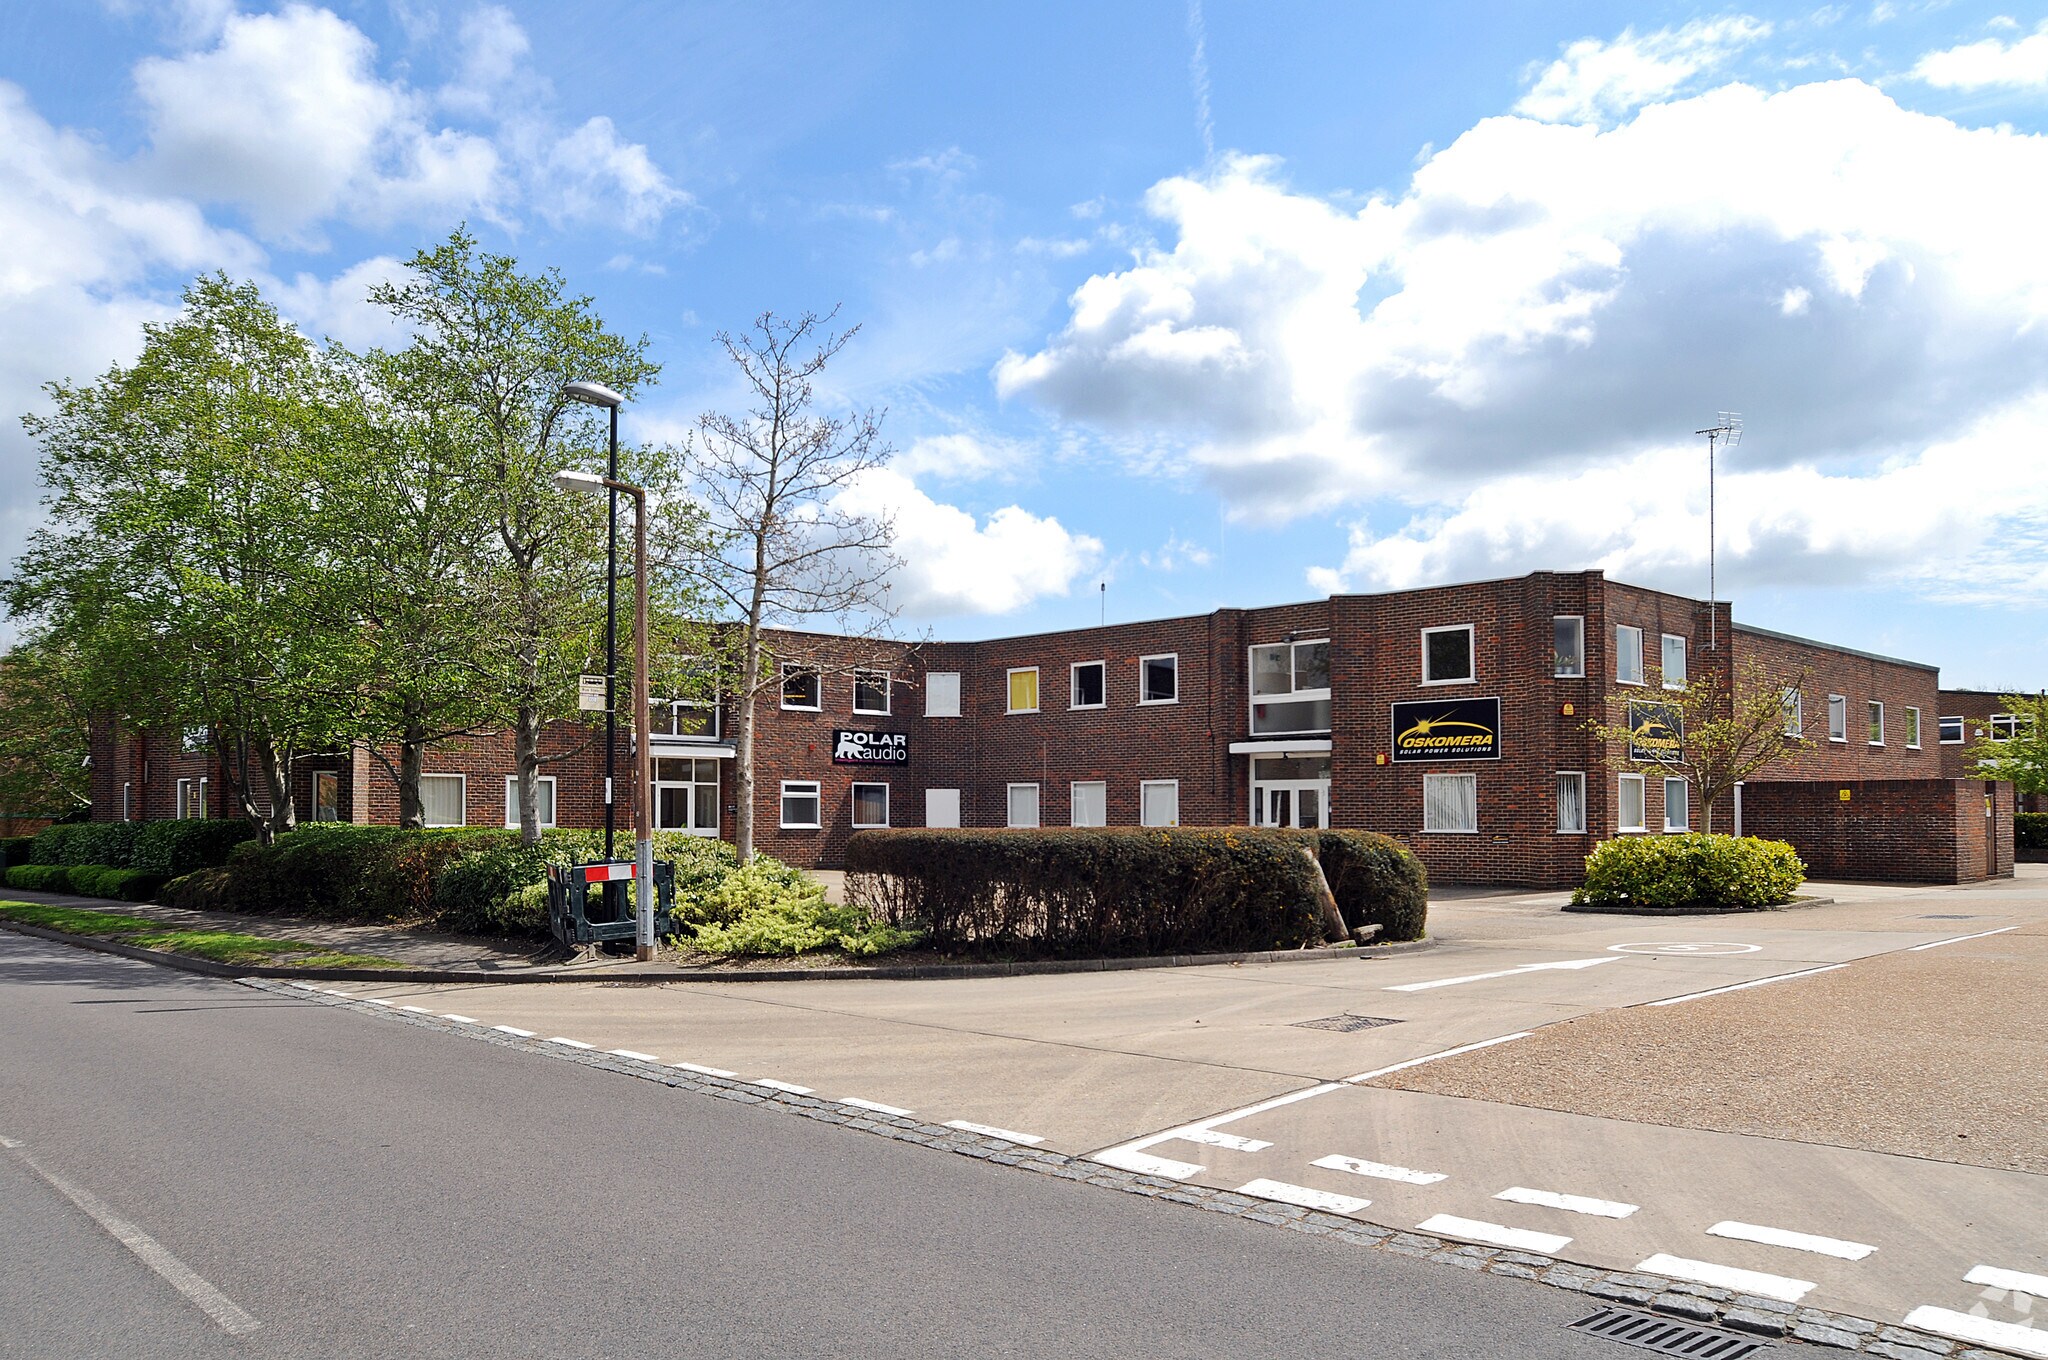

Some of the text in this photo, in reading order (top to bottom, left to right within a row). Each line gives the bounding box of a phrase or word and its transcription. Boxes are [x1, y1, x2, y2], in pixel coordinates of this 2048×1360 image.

[840, 732, 906, 746] POLAR
[1403, 735, 1493, 748] OSKOMERA
[863, 746, 906, 760] audio
